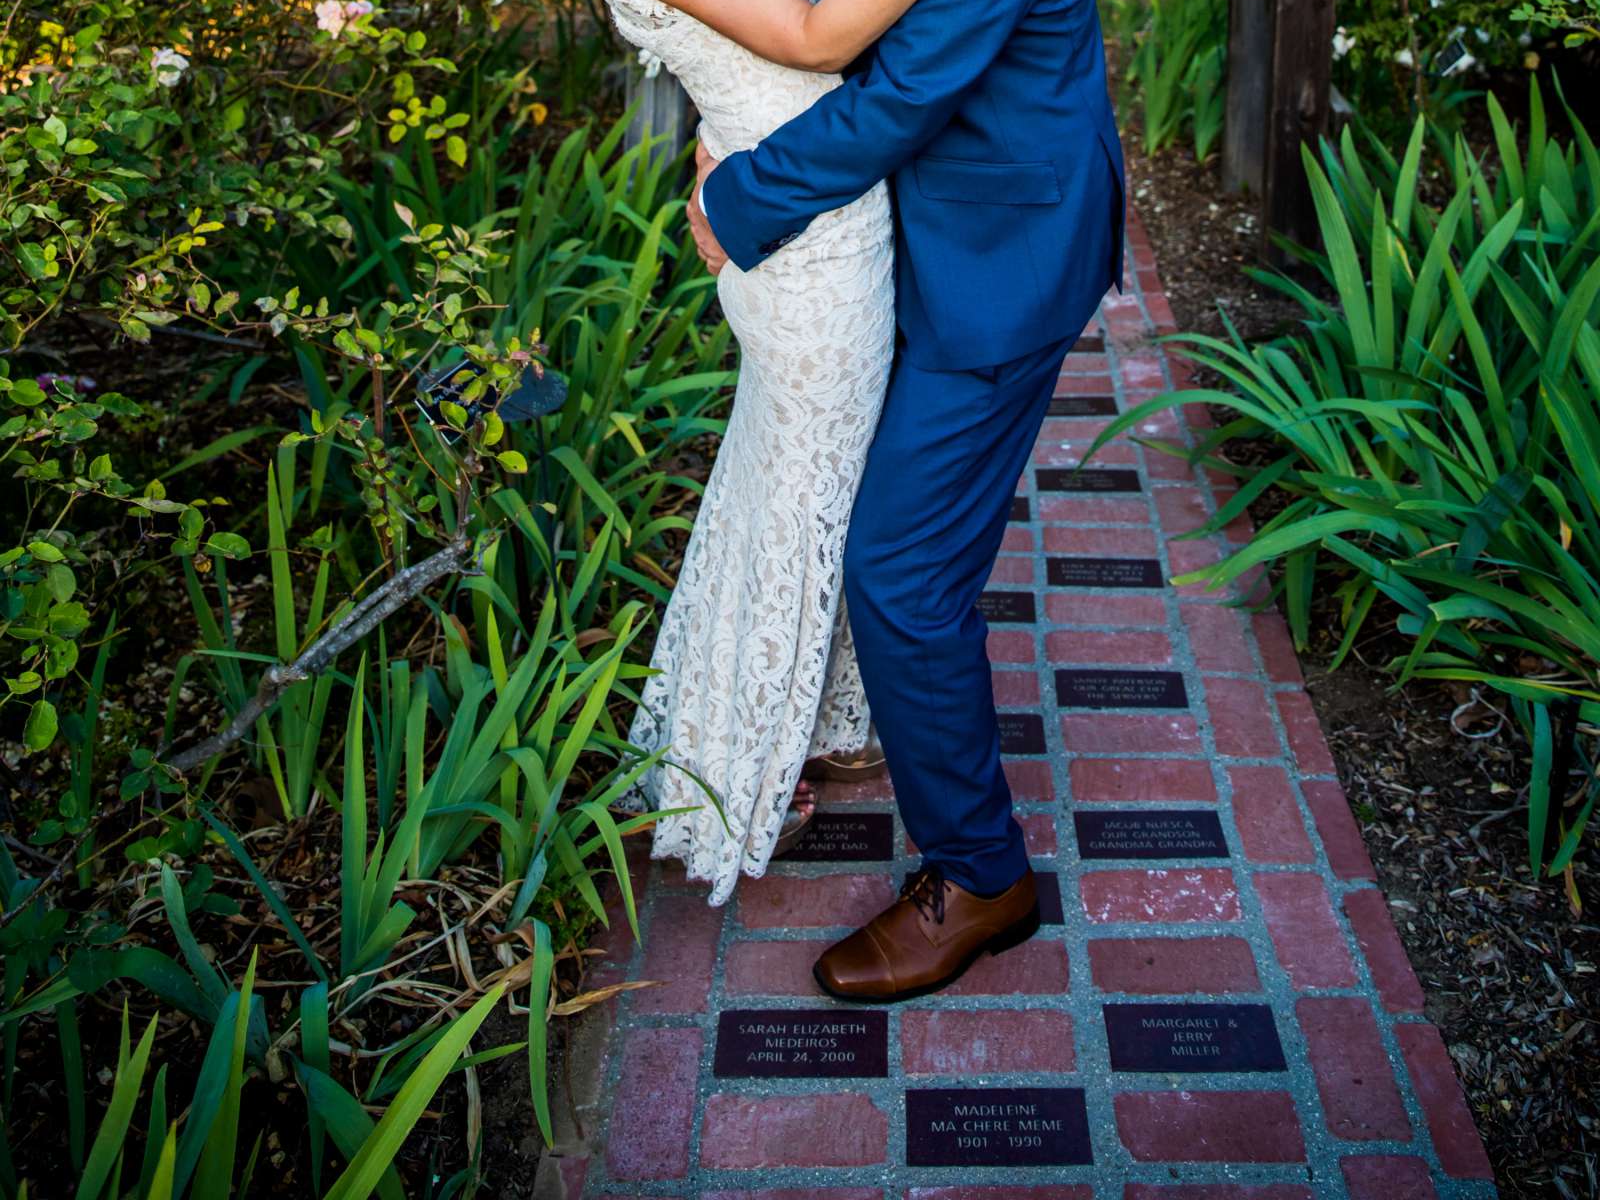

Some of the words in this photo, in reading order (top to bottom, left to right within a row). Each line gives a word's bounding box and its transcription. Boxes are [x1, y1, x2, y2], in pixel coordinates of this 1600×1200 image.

[1101, 685, 1136, 693] GREAT
[817, 823, 868, 832] NUESCA
[1104, 821, 1141, 830] JACOB
[1145, 820, 1194, 830] NUESCA
[823, 832, 850, 841] SON
[1101, 830, 1127, 839] OUR
[1132, 830, 1201, 839] GRANDSON
[807, 842, 837, 851] AND
[841, 842, 869, 851] DAD
[1089, 839, 1154, 849] GRANDMA
[1157, 839, 1217, 849] GRANDPA
[1142, 1018, 1220, 1029] MARGARET
[1227, 1018, 1239, 1029] &
[738, 1024, 787, 1035] SARAH
[793, 1024, 867, 1035] ELIZABETH
[1173, 1032, 1214, 1043] JERRY
[765, 1038, 838, 1049] MEDEIROS
[1170, 1045, 1221, 1057] MILLER
[746, 1051, 786, 1063] APRIL
[792, 1051, 813, 1064] 24,
[819, 1051, 856, 1063] 2000
[953, 1104, 1039, 1117] MADELEINE
[931, 1120, 957, 1133] MA
[962, 1120, 1011, 1133] CHERE
[1018, 1119, 1064, 1132] MEME
[956, 1135, 989, 1149] 1901
[1007, 1135, 1043, 1147] 1990
